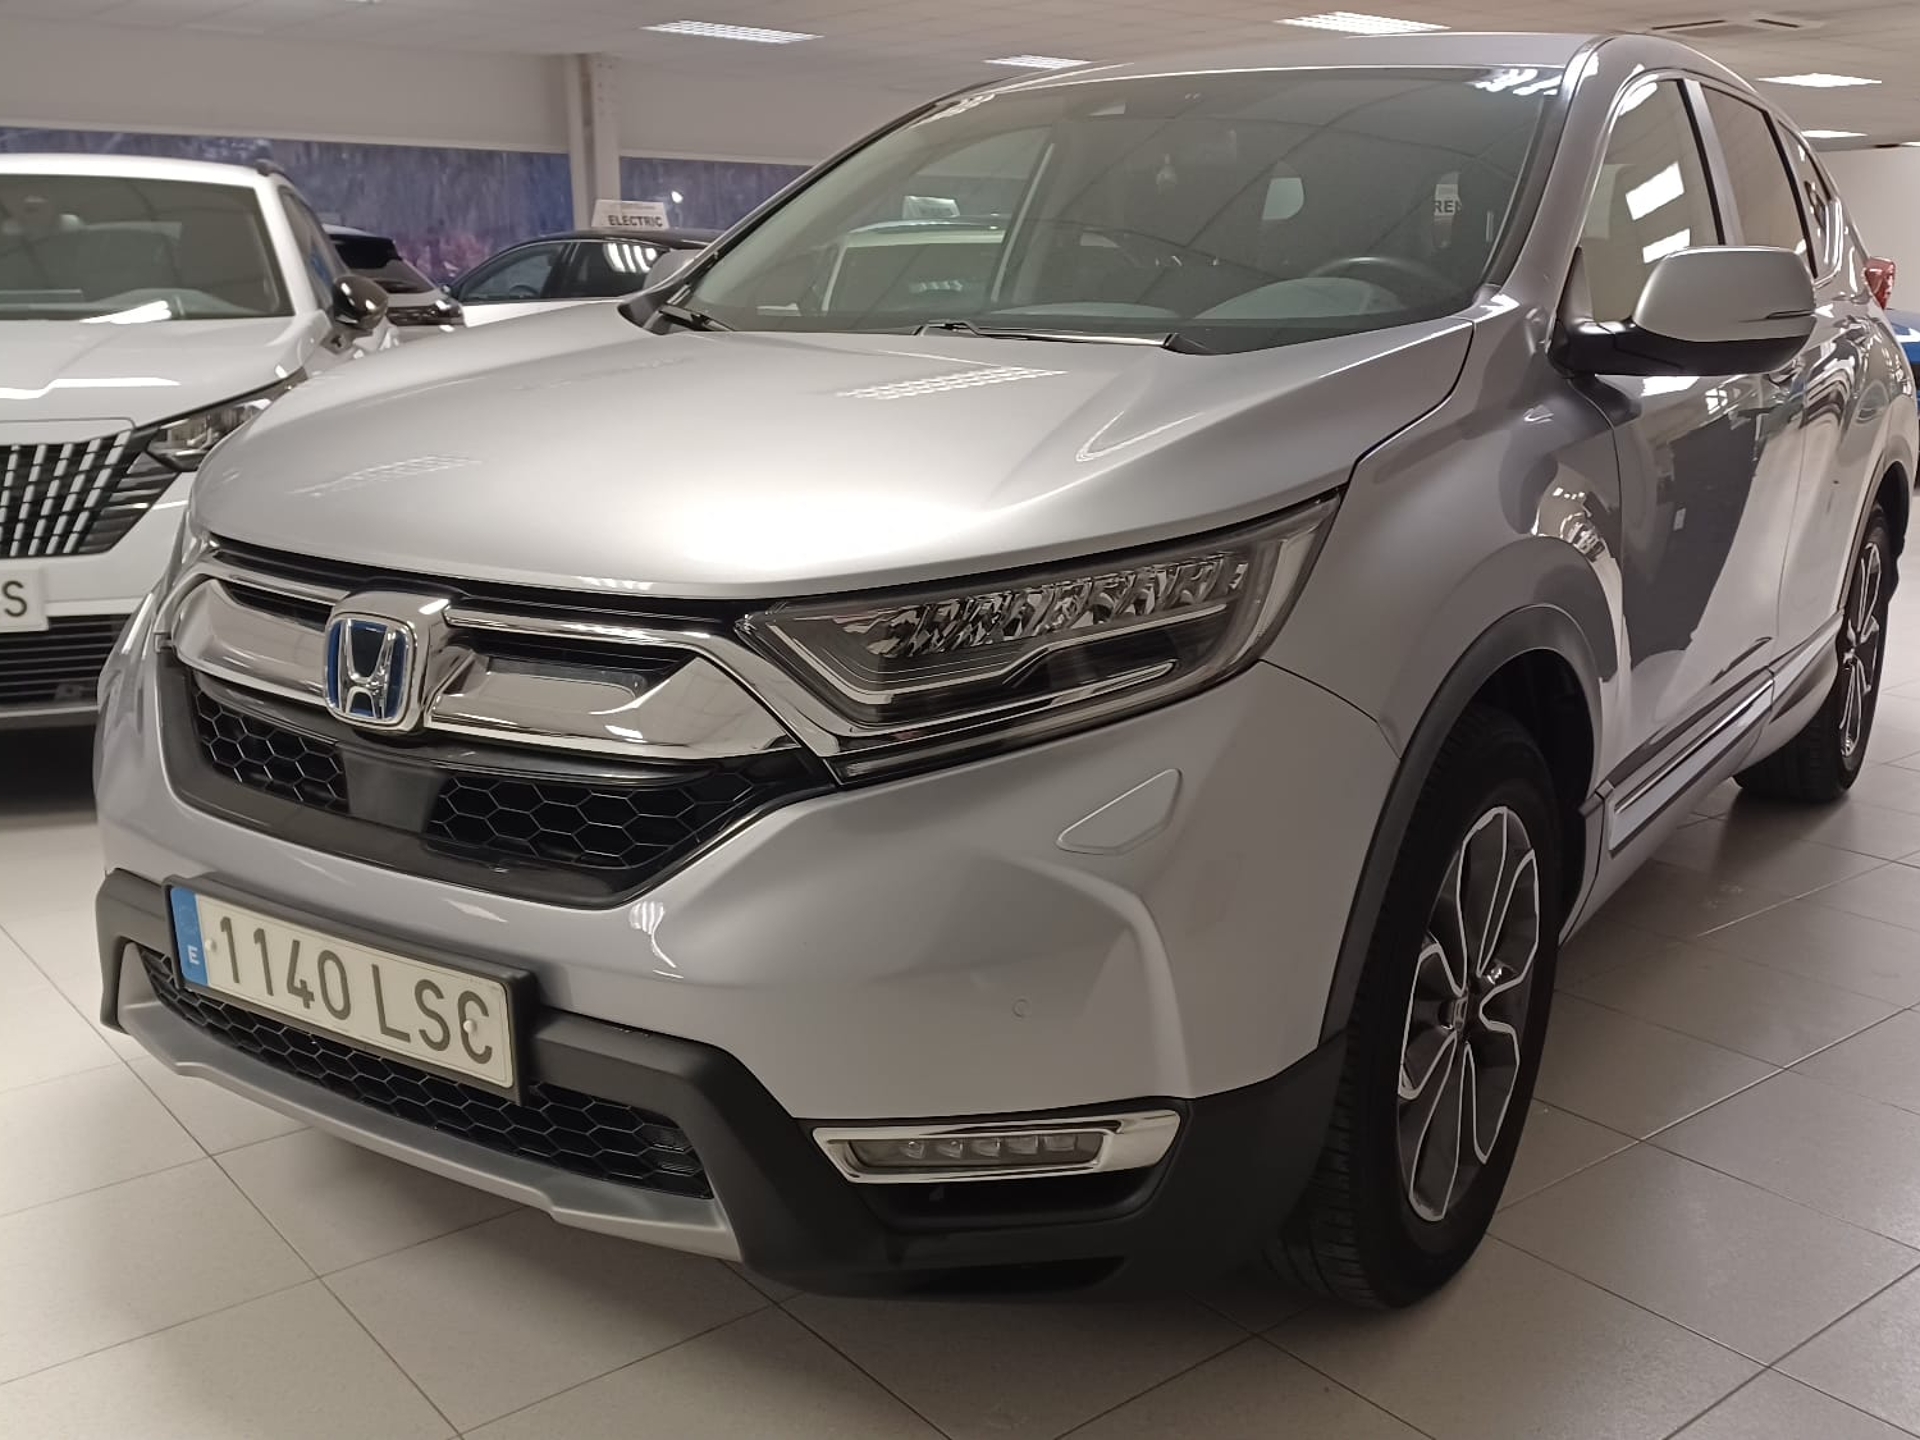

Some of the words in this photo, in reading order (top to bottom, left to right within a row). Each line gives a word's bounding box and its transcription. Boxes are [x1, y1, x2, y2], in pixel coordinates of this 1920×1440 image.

[608, 214, 664, 228] ELECTRIC
[187, 945, 200, 966] E
[220, 916, 351, 1021] 1140
[371, 963, 493, 1065] LSC
